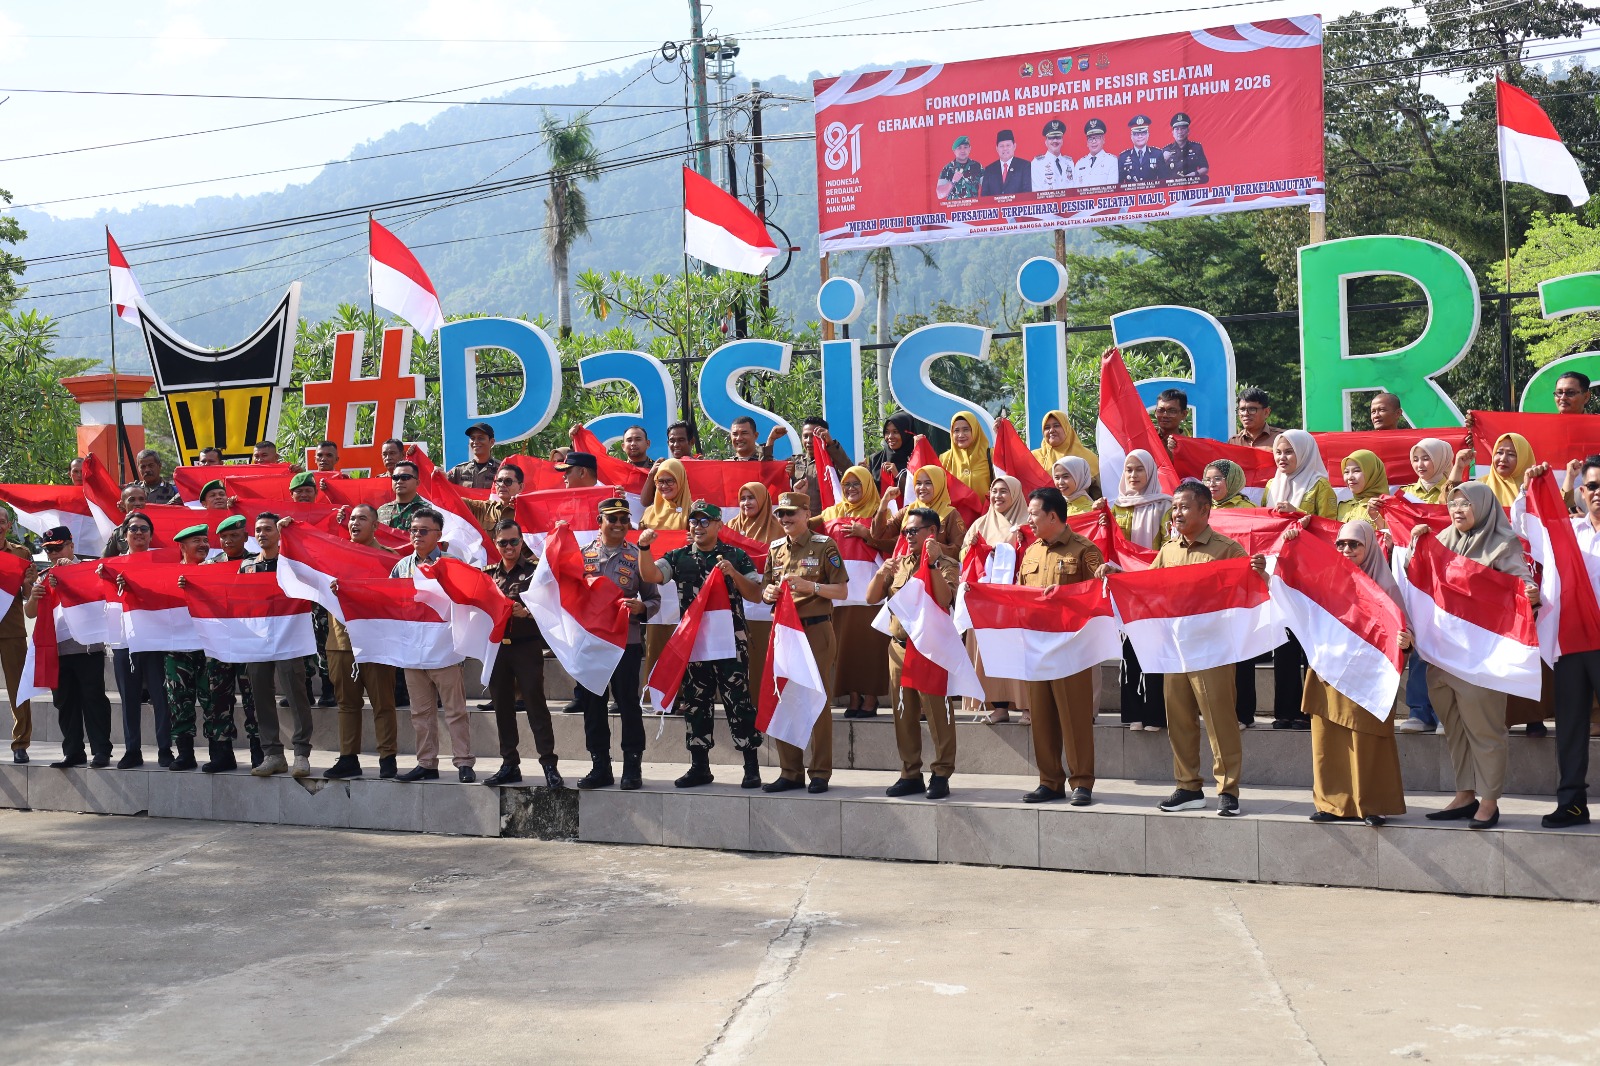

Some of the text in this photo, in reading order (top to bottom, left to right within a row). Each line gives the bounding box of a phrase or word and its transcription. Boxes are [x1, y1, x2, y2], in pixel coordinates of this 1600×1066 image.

[925, 63, 1213, 110] FORKOPIMDA KABUPATEN PESISIR SELATAN
[877, 74, 1271, 133] GERAKAN PEMBAGIAN BENDERA MERAH PUTIH TAHUN 2026
[823, 121, 864, 176] 81
[825, 177, 860, 188] INDONESIA
[825, 185, 863, 196] BERDAULAT
[825, 195, 855, 205] ADIL DAN
[826, 204, 856, 214] MAKMUR
[879, 216, 904, 229] PUTIH
[906, 213, 948, 227] BERKIBAR,
[951, 208, 999, 223] PERSATUAN
[1001, 203, 1059, 218] TERPELIHARA
[1061, 200, 1095, 213] PESISIR
[1097, 195, 1135, 208] SELATAN
[1138, 192, 1166, 205] MAJU,
[1168, 187, 1209, 201] TUMBUH
[1212, 186, 1231, 198] DAN
[989, 224, 1018, 232] KESATUAN
[1019, 222, 1042, 230] BANGSA
[1056, 218, 1081, 227] POLITIK
[1082, 215, 1117, 224] KABUPATEN
[1117, 213, 1142, 221] PESISIR
